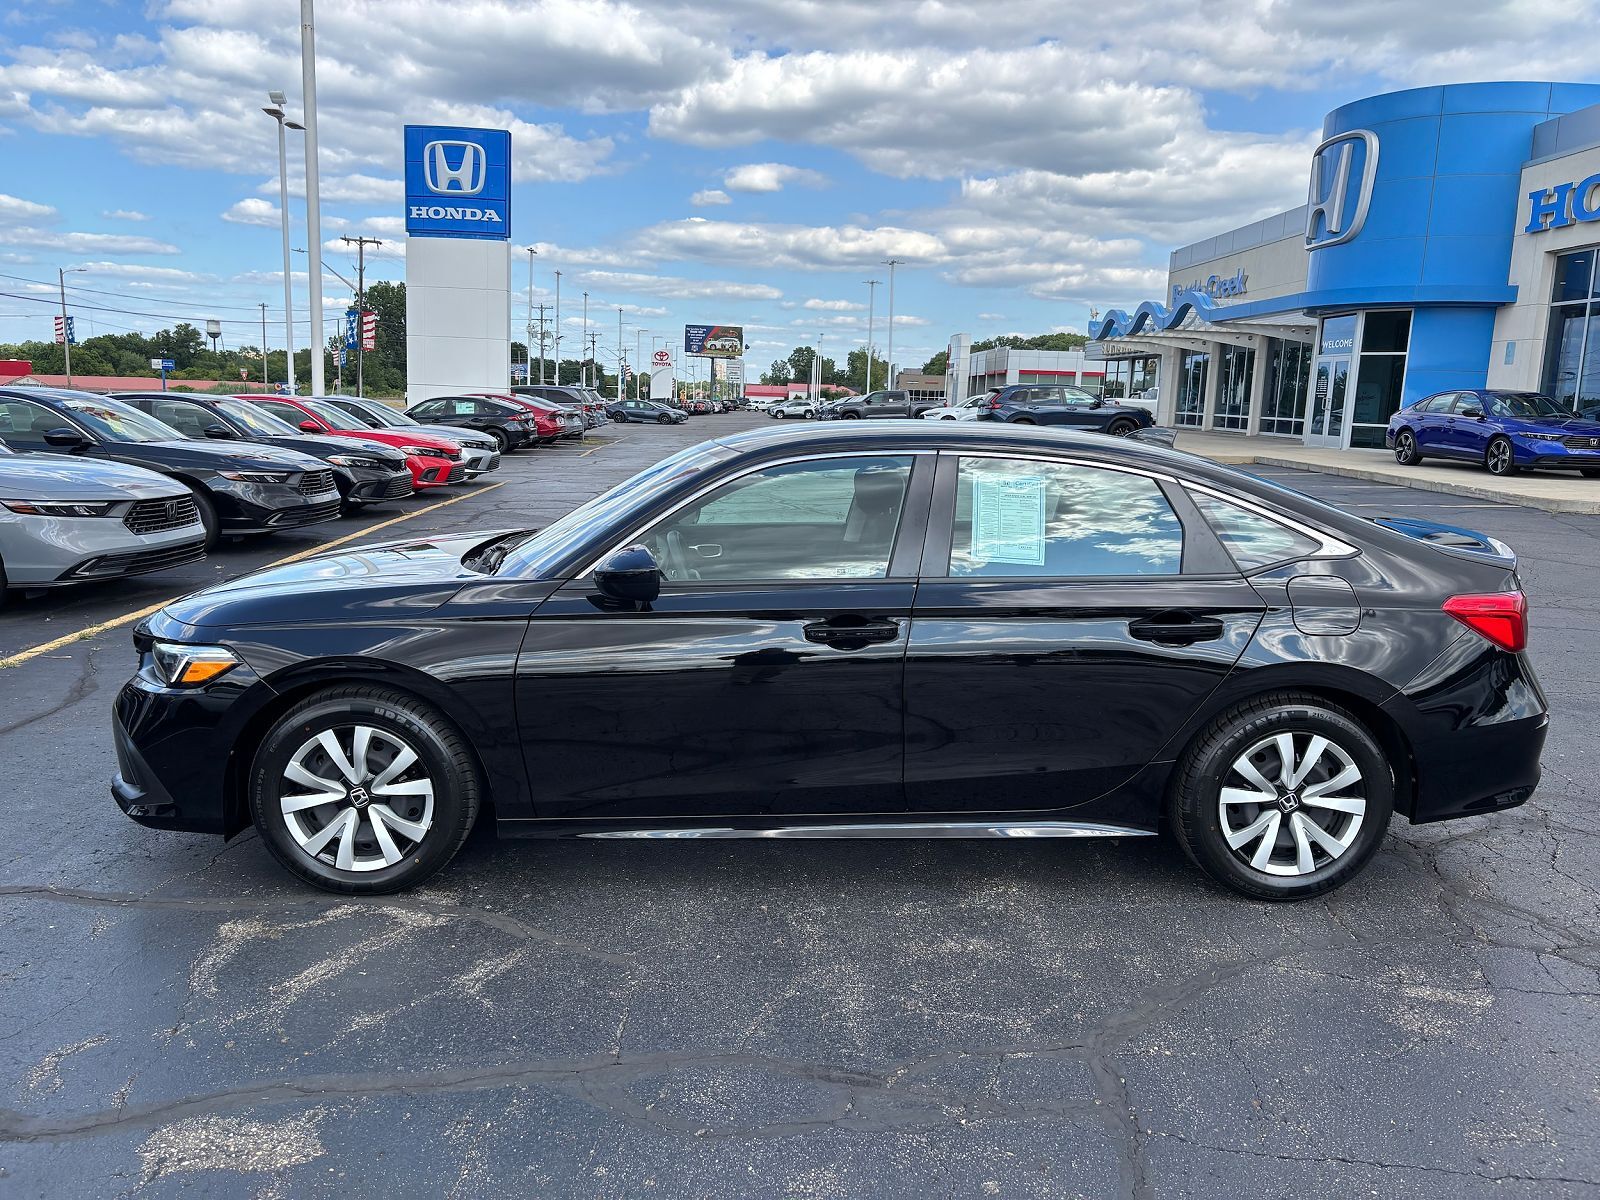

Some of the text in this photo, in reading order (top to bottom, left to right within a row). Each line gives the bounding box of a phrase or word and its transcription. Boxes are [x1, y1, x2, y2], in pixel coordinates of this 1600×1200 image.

[410, 206, 502, 222] HONDA
[1206, 267, 1249, 298] Creek
[1323, 339, 1353, 348] WELCOME
